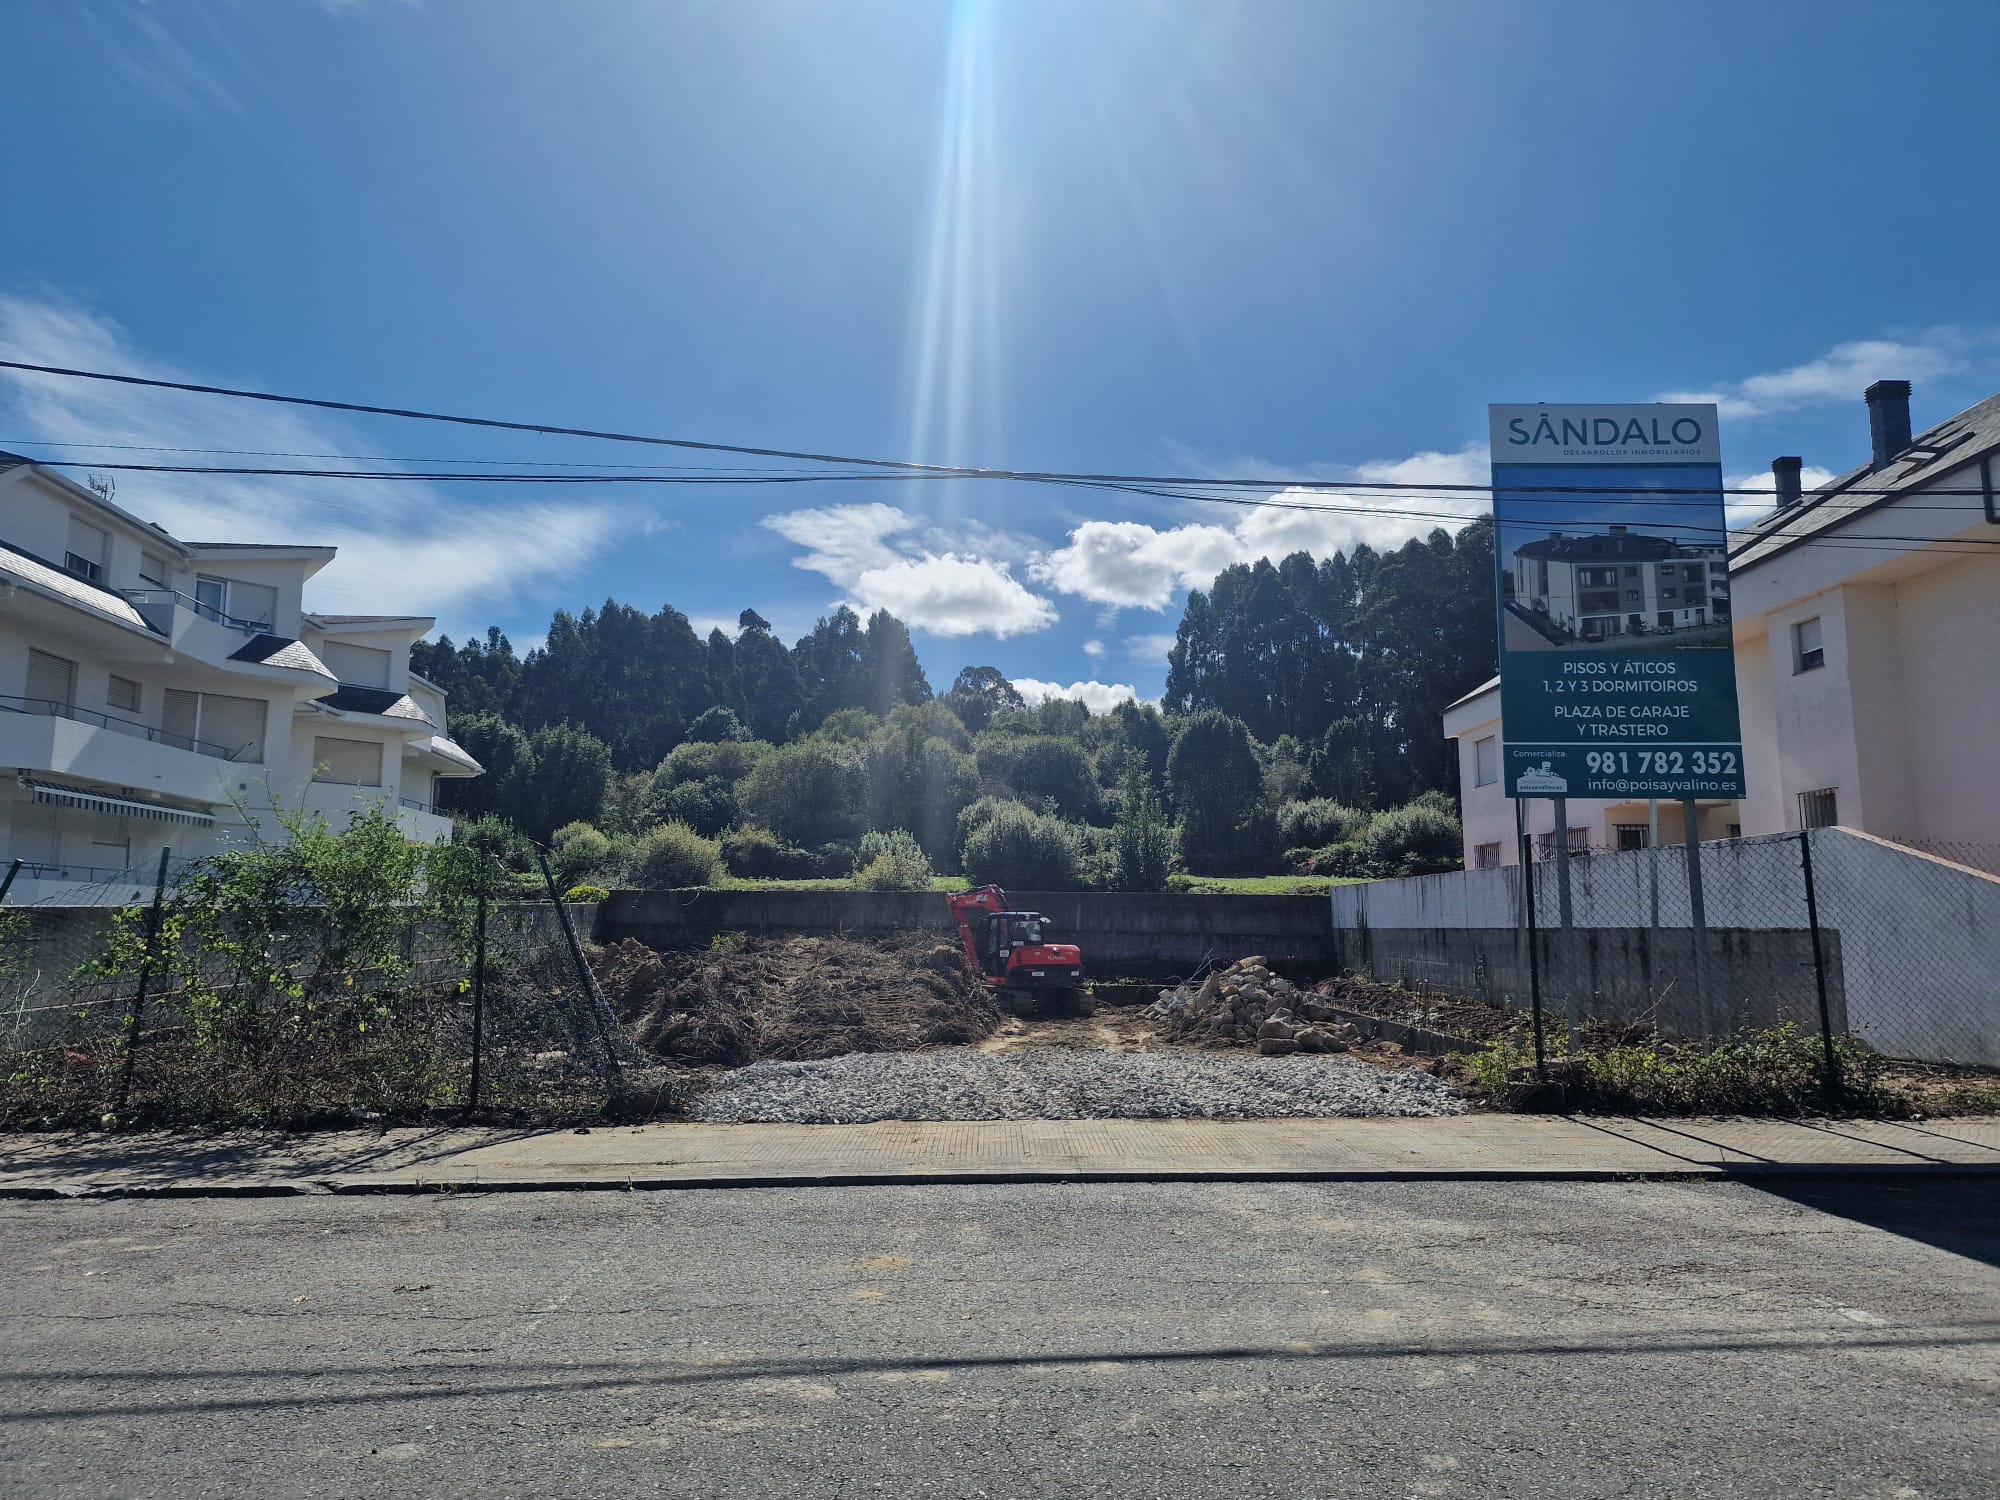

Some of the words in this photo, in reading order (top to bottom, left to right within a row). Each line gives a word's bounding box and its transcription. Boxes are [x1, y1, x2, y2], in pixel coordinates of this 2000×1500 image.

[1563, 662, 1607, 674] PISOS
[1610, 662, 1620, 674] Y
[1623, 659, 1676, 674] ÁTICOS
[1556, 680, 1565, 692] 2
[1567, 680, 1577, 692] Y
[1580, 680, 1589, 692] 3
[1592, 680, 1698, 692] DORMITOIROS
[1554, 706, 1601, 718] PLAZA
[1606, 706, 1626, 718] DE
[1630, 706, 1690, 718] GARAJE
[1576, 724, 1587, 736] Y
[1589, 724, 1669, 736] TRASTERO
[1586, 751, 1629, 774] 981
[1638, 751, 1685, 774] 782
[1692, 751, 1737, 774] 352
[1588, 778, 1737, 791] info@poisayvalino.es
